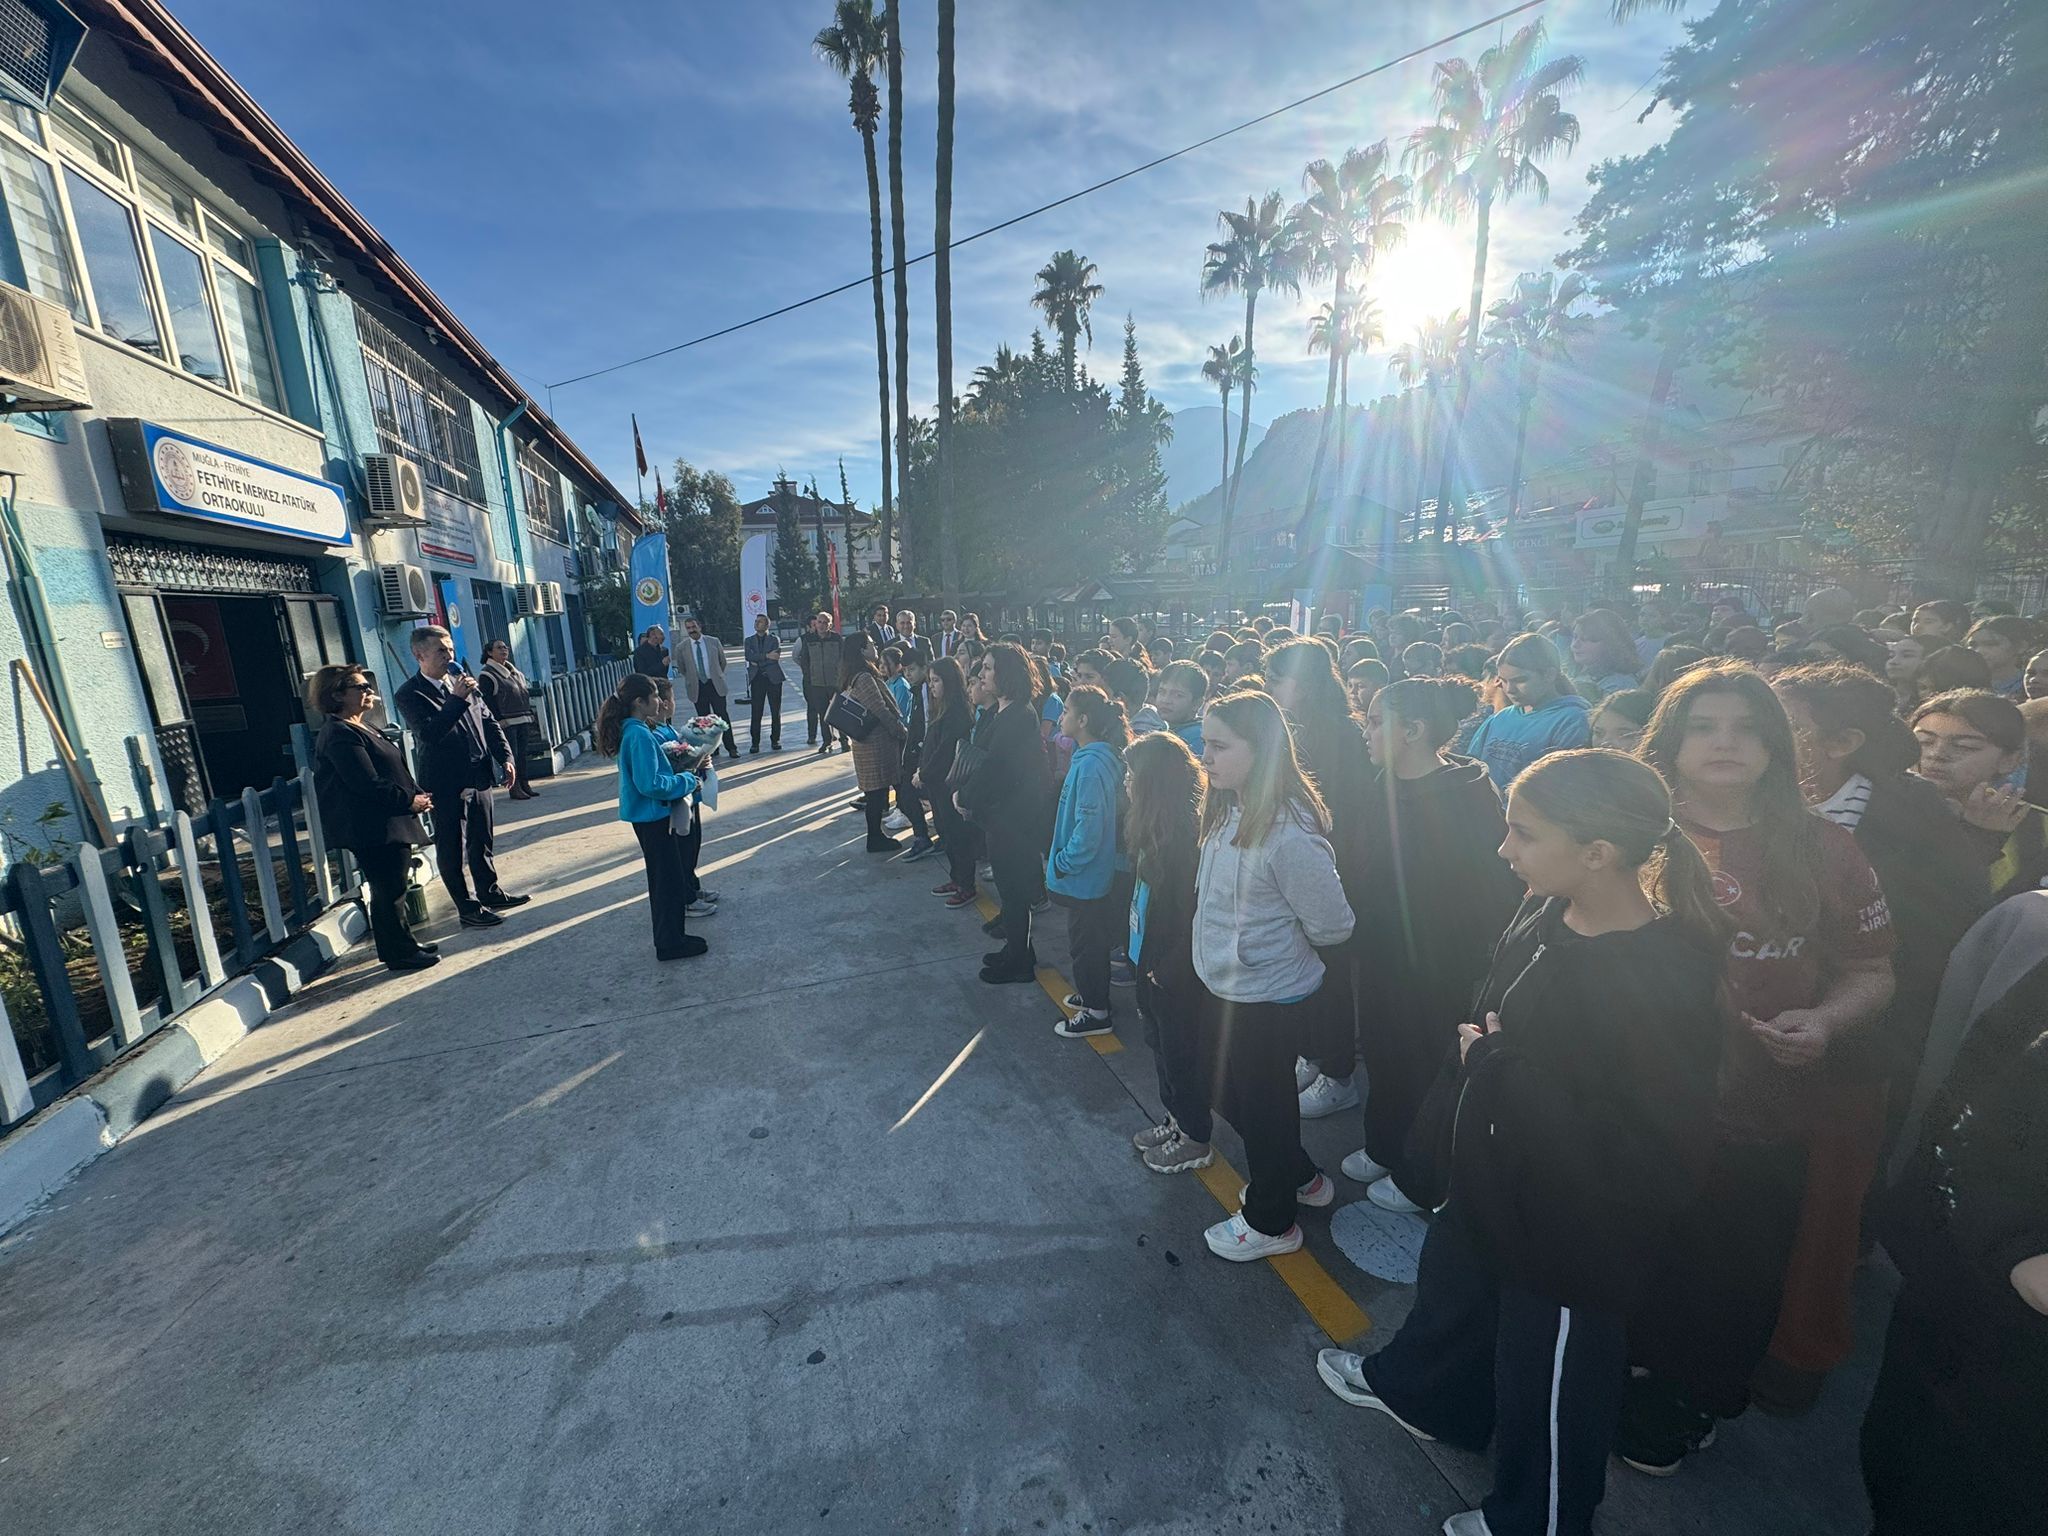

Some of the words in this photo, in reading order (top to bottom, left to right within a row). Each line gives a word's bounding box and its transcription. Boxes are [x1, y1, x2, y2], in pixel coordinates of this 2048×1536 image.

[192, 451, 219, 468] MUĞLA
[224, 460, 250, 477] FETHİYE
[196, 469, 242, 494] FETHİYE
[243, 482, 280, 504] MERKEZ
[282, 493, 317, 513] ATATÜRK
[202, 491, 265, 517] ORTAOKULU
